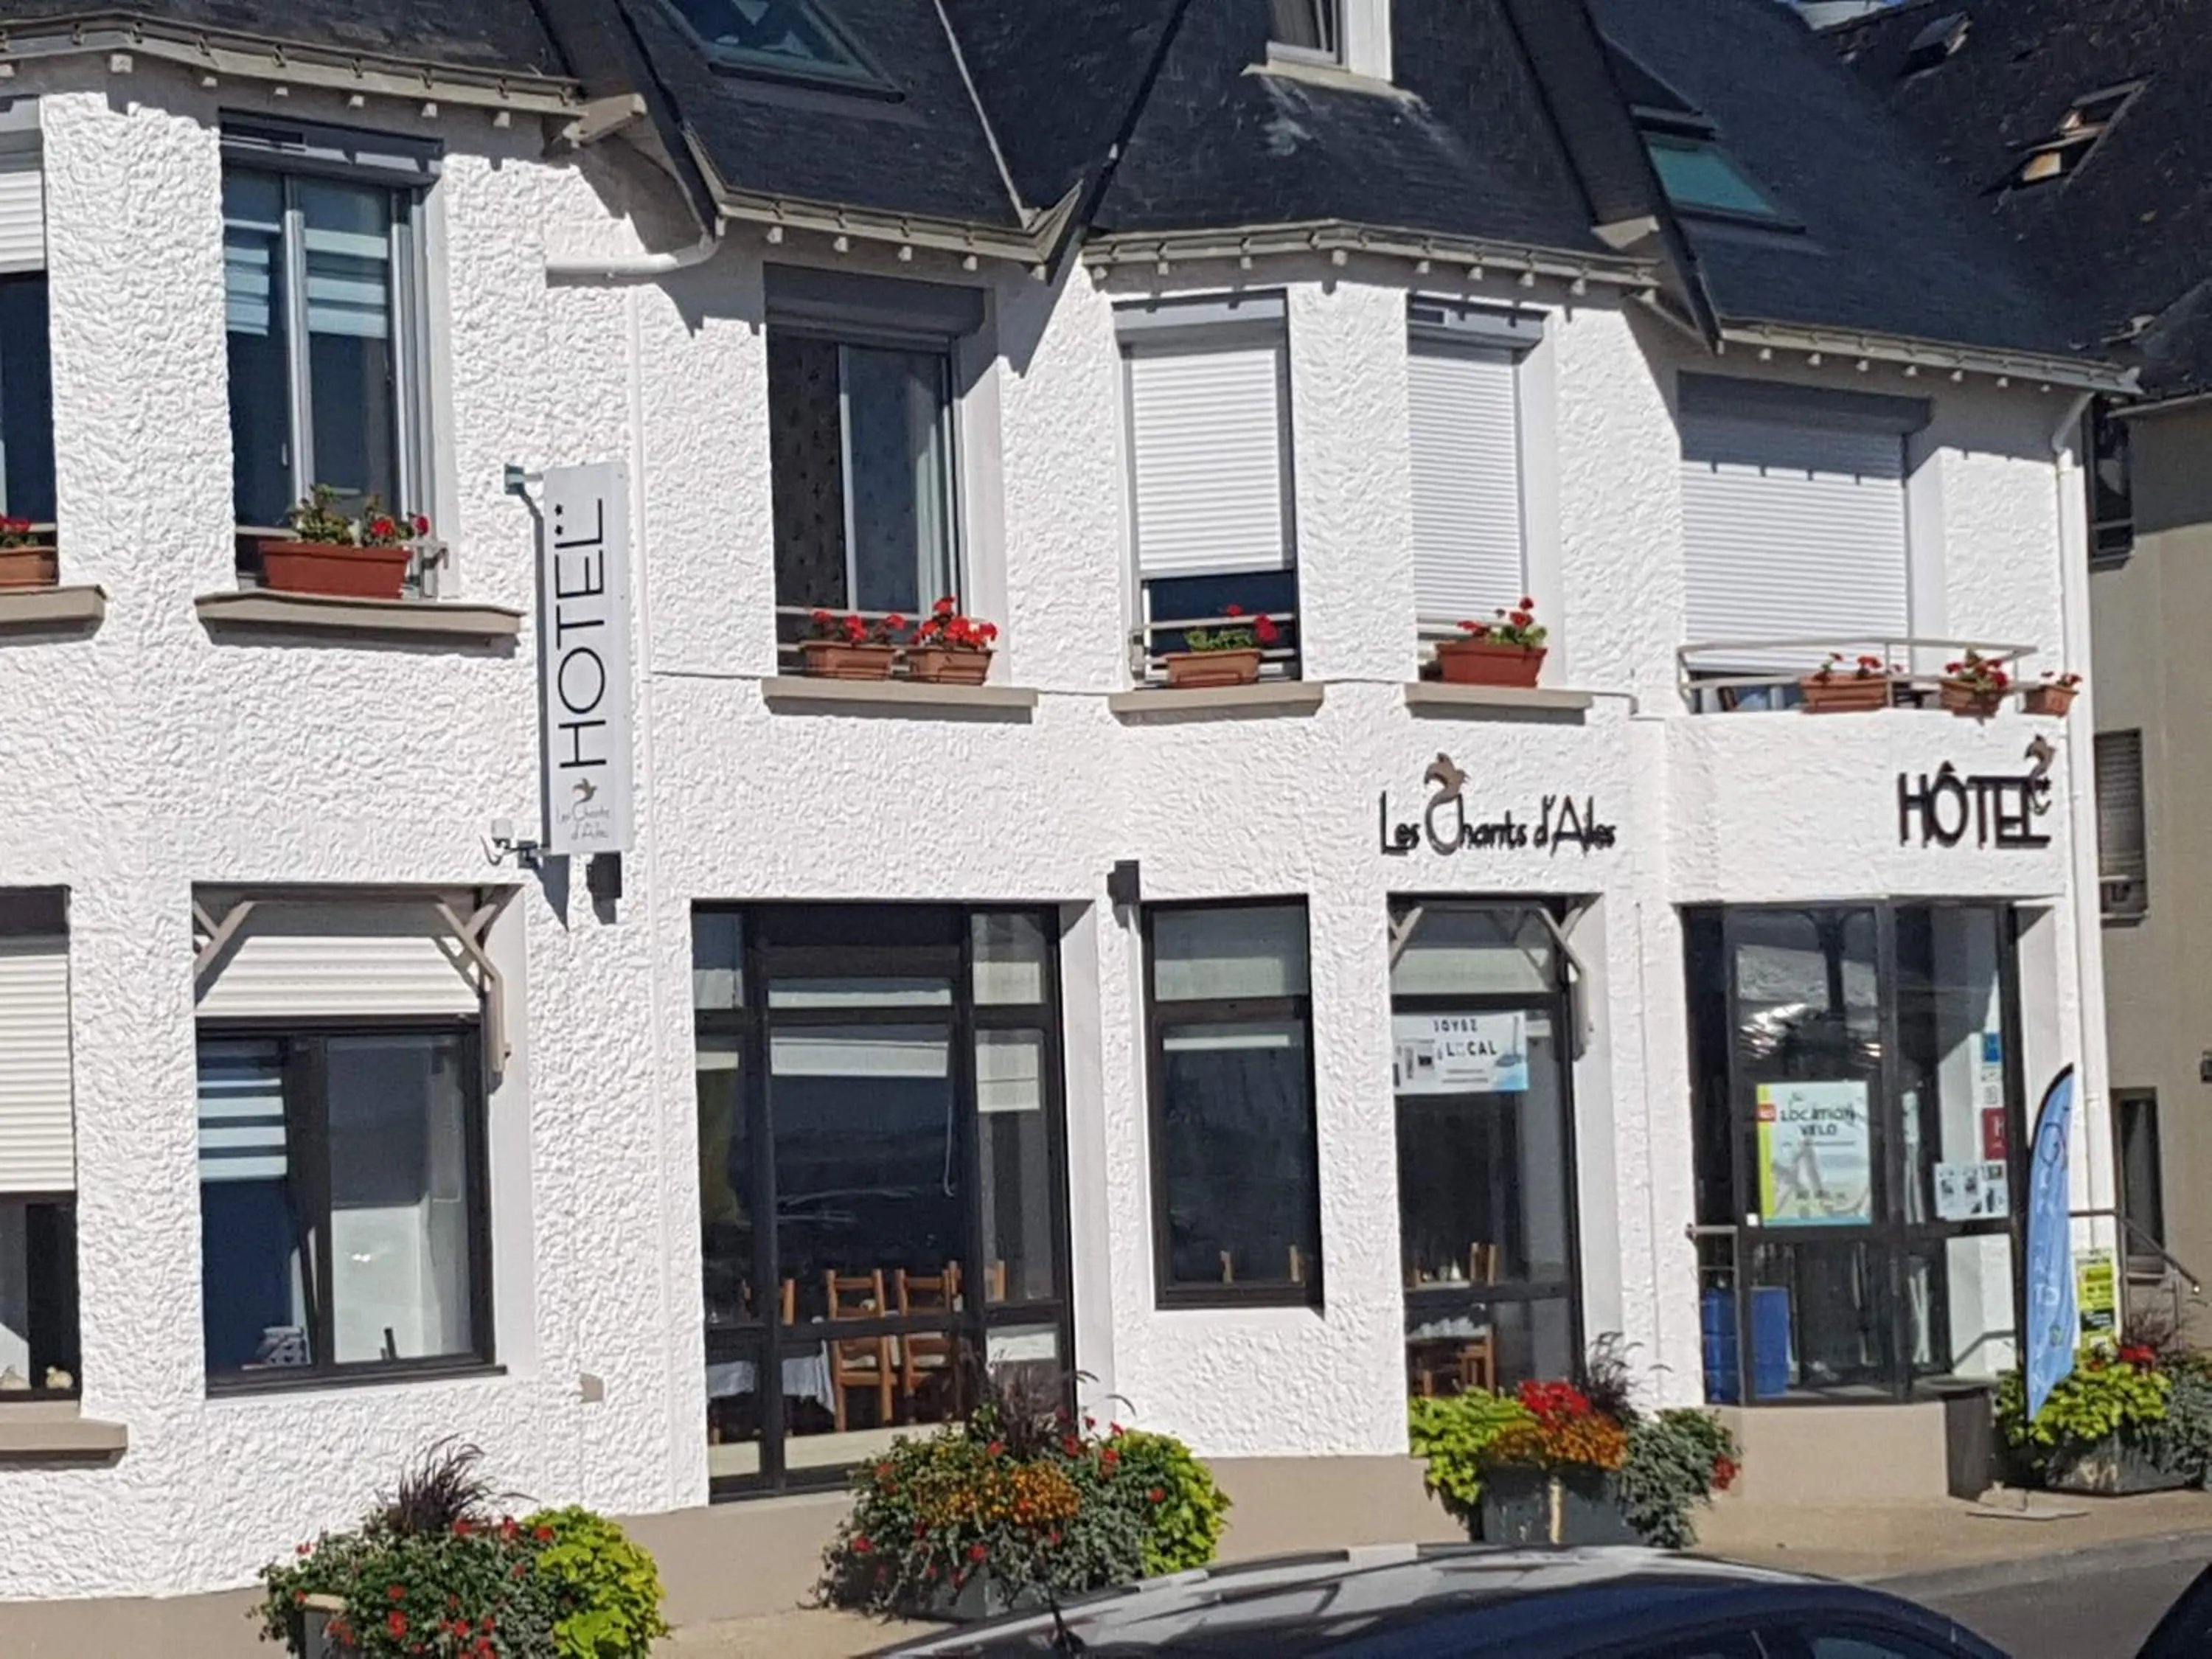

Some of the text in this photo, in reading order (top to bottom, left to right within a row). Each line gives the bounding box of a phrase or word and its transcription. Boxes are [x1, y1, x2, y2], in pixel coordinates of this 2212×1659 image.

[554, 498, 607, 769] HOTEL
[1380, 790, 1420, 855] Les
[1425, 792, 1528, 856] Chants
[1897, 760, 2052, 849] HÔTEL
